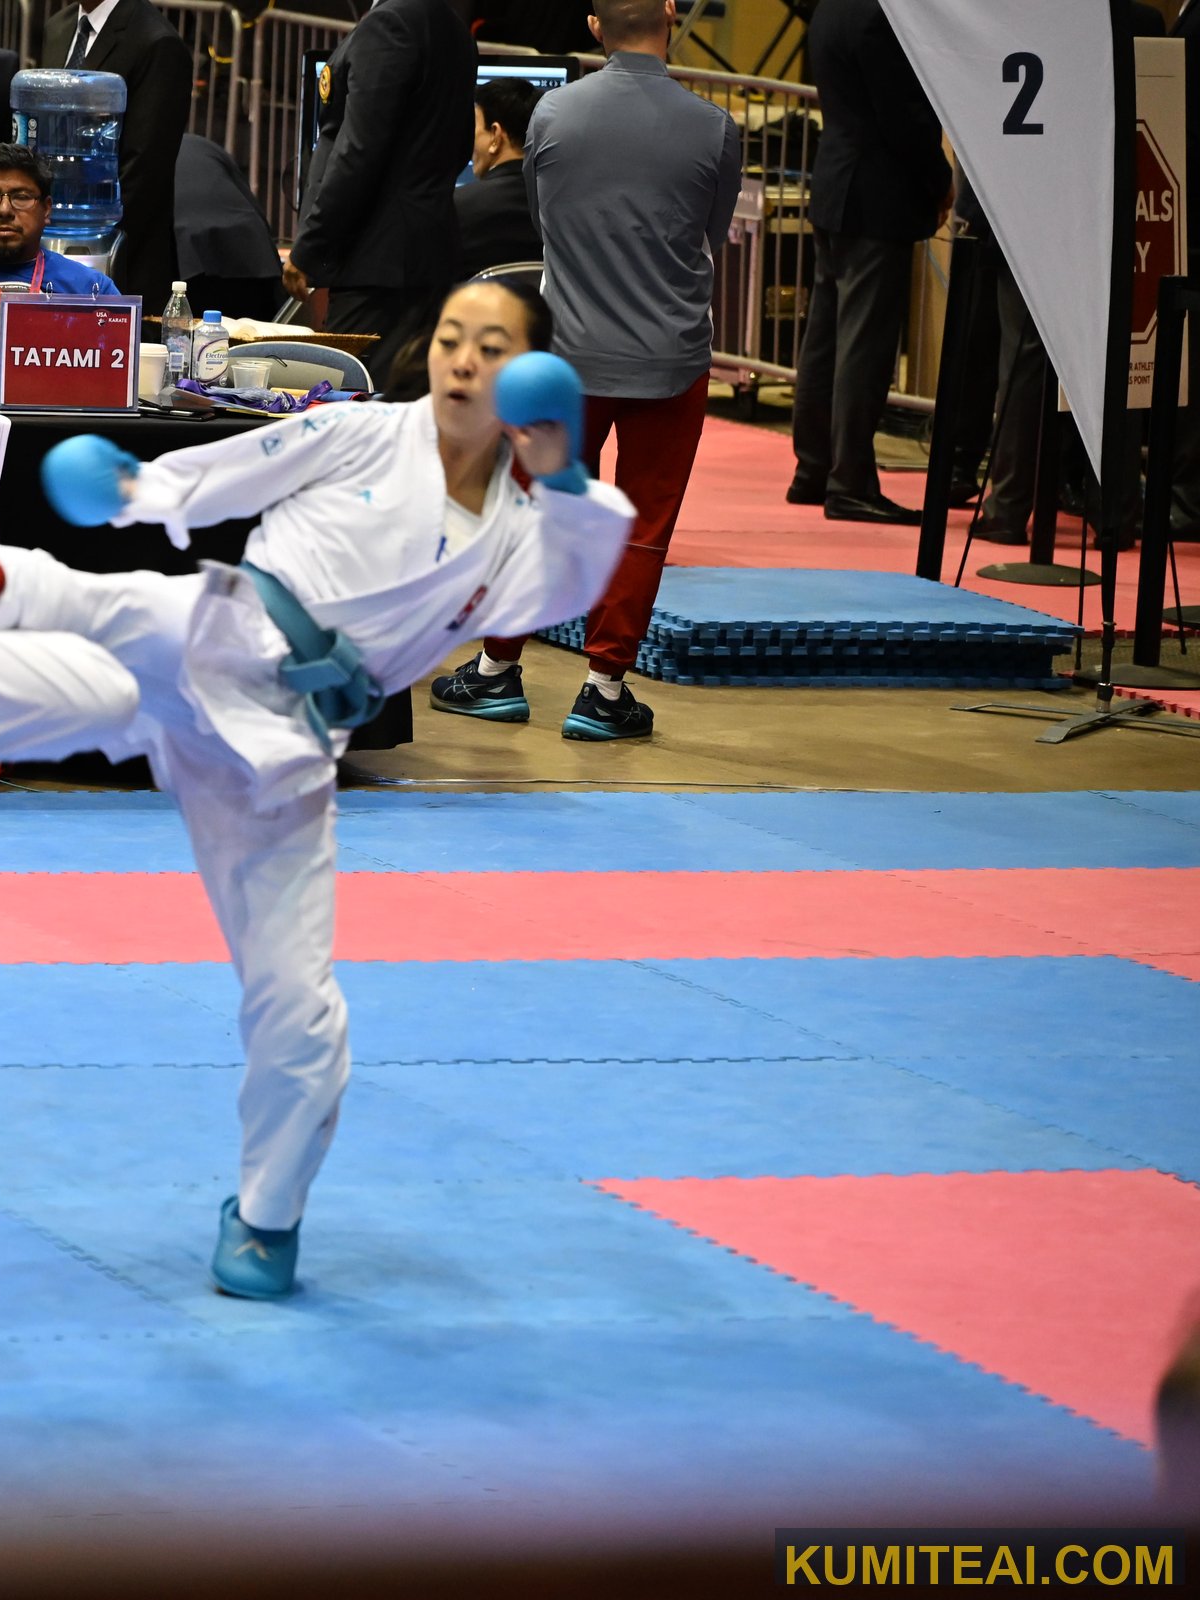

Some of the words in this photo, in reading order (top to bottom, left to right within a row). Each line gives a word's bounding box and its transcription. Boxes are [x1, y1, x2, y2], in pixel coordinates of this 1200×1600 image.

[1002, 52, 1044, 135] 2
[10, 346, 101, 368] TATAMI
[110, 349, 125, 369] 2
[1133, 375, 1150, 385] POINT
